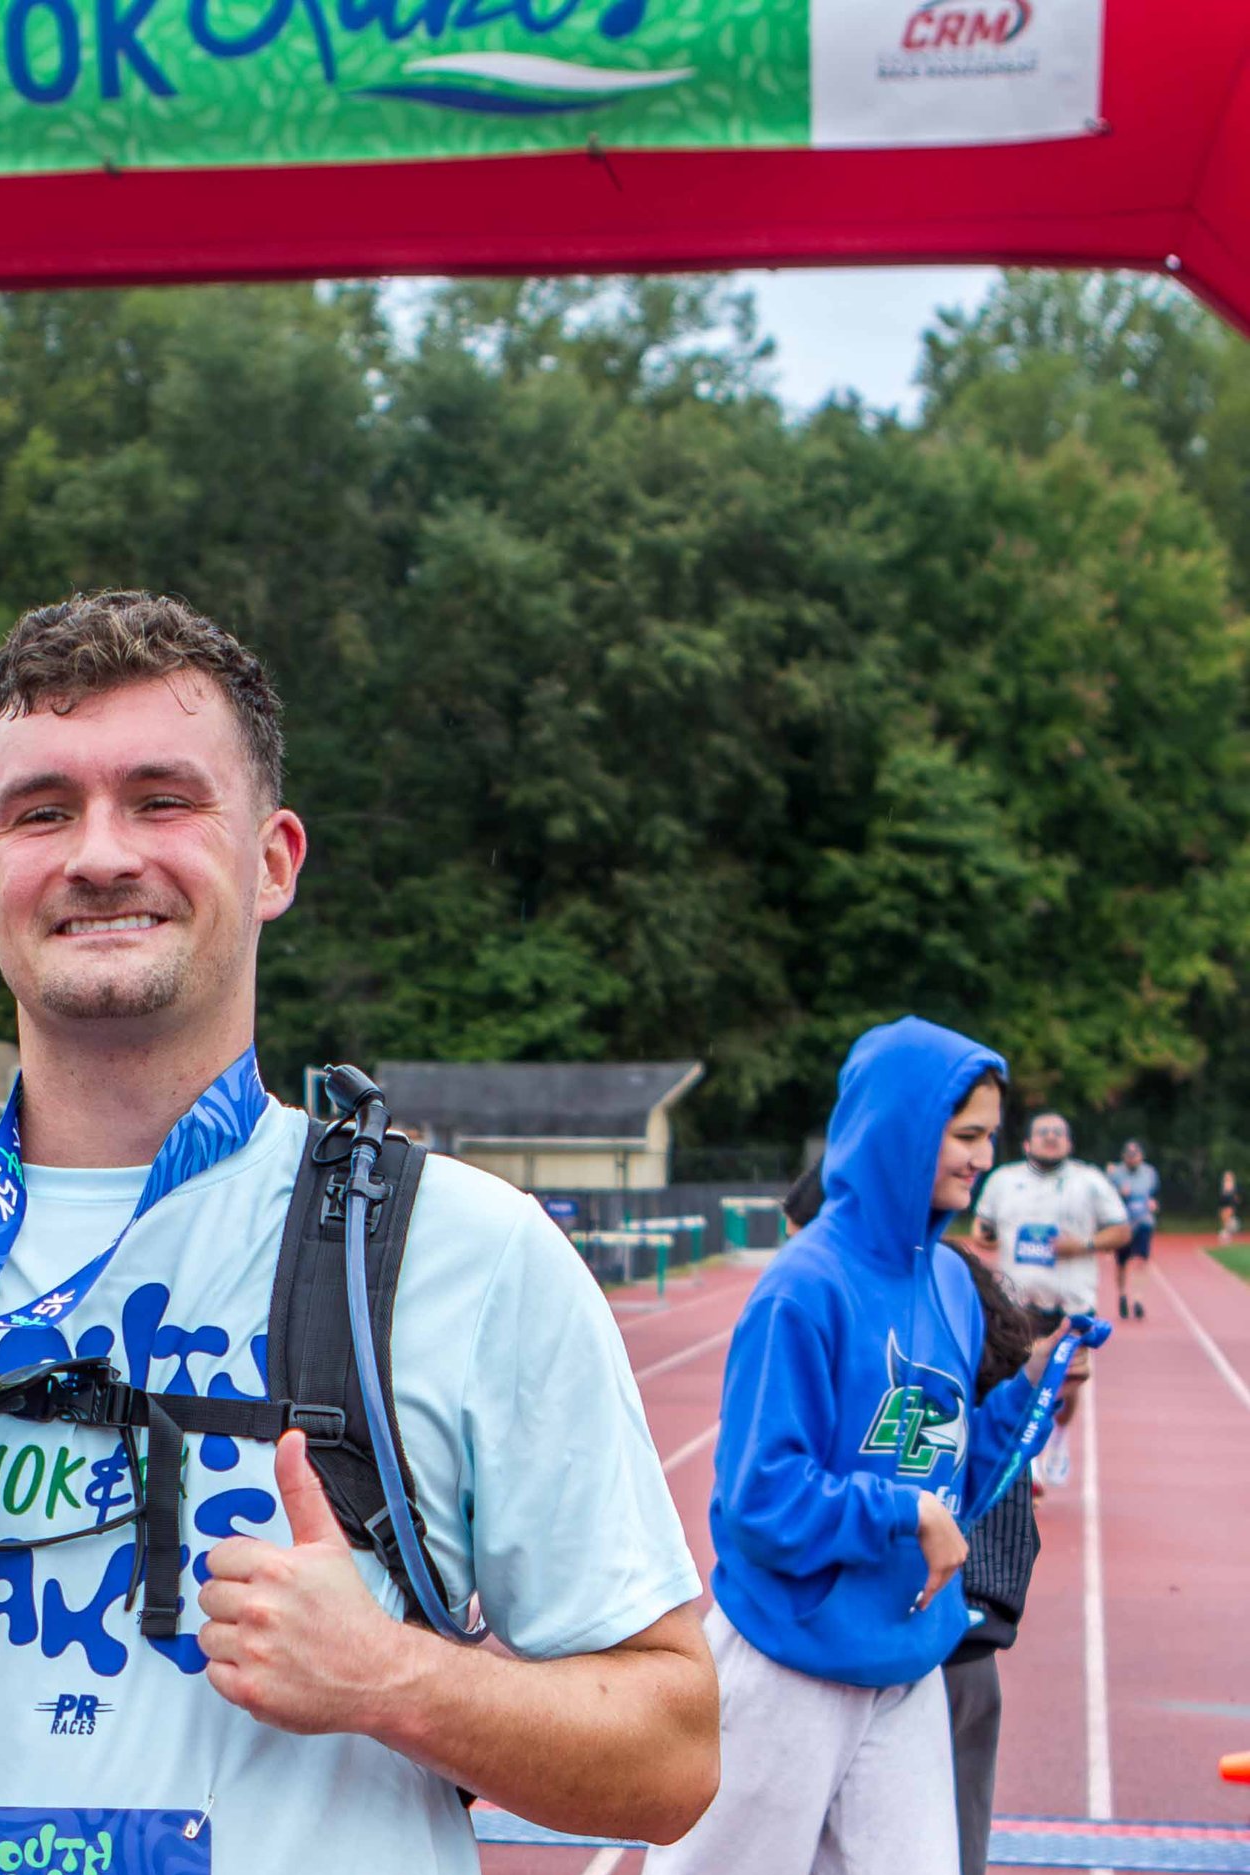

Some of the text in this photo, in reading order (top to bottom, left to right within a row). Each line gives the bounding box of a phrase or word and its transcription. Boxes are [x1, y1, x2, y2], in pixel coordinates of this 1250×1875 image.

[902, 11, 1010, 49] CRM
[32, 1289, 76, 1318] 5K
[54, 1693, 99, 1721] PR
[50, 1719, 97, 1735] RACES
